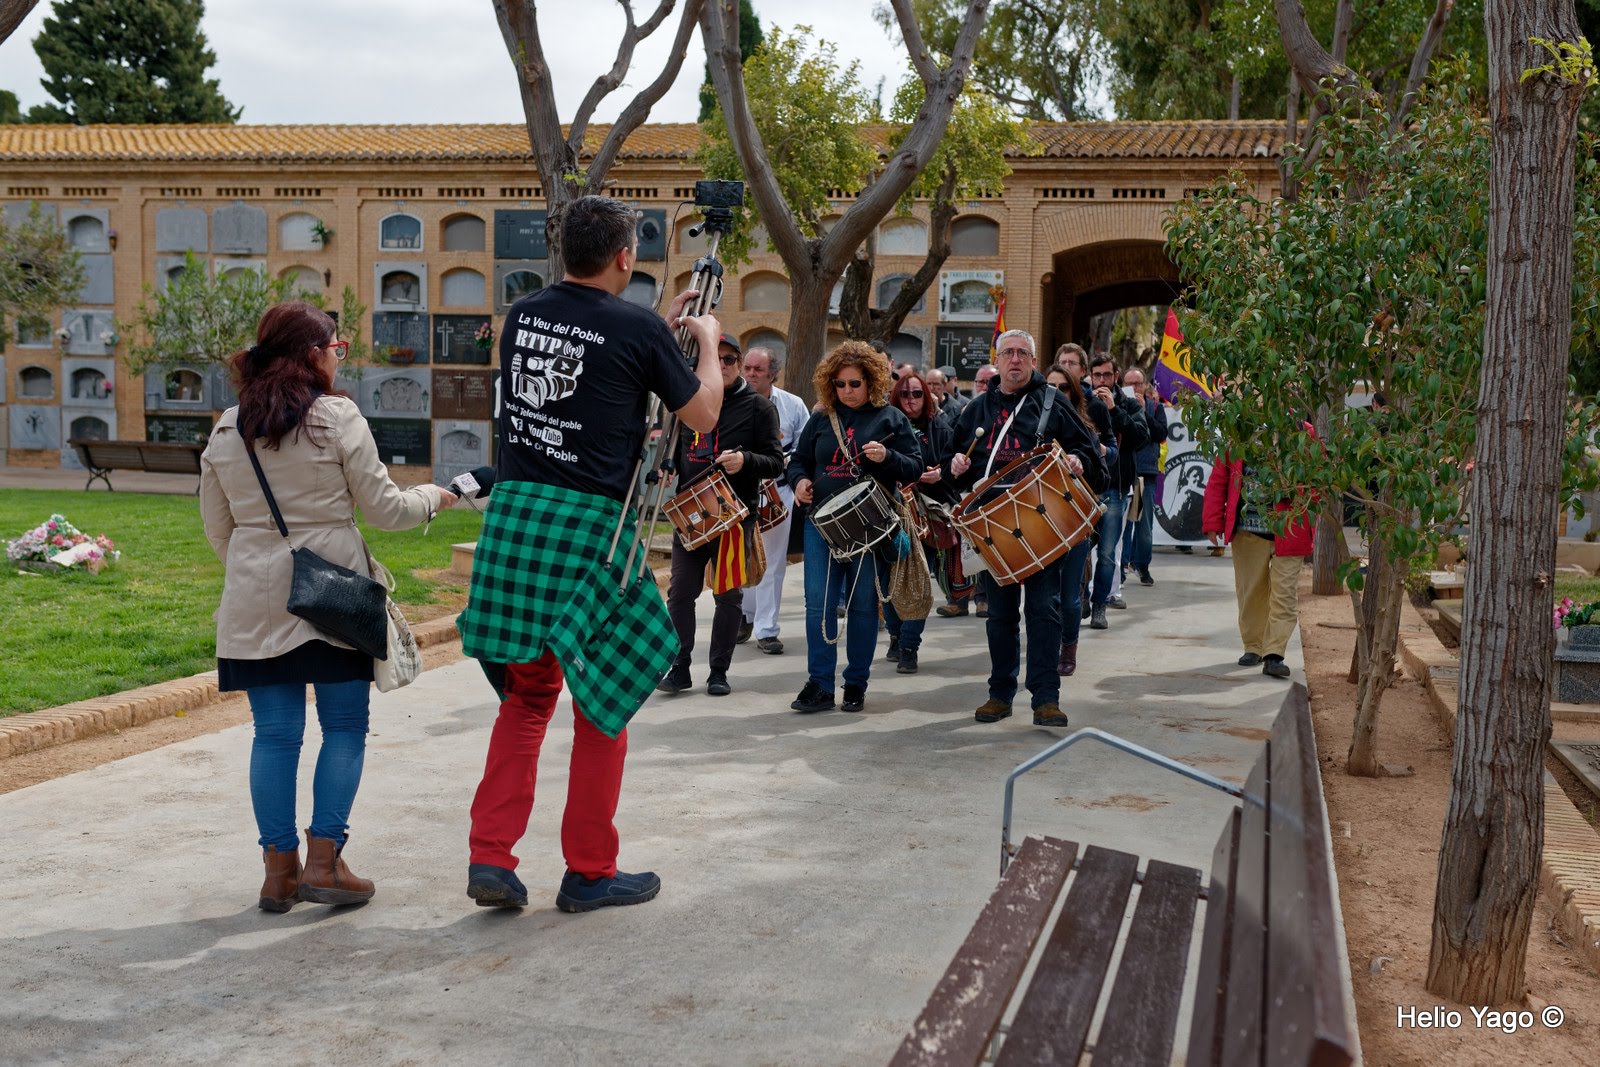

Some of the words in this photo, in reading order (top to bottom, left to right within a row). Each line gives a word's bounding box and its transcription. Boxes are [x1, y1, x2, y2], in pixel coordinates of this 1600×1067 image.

[515, 328, 562, 354] RTVP
[518, 313, 531, 325] La
[533, 316, 551, 331] Veu
[552, 322, 570, 335] del
[570, 326, 605, 345] Poble
[520, 407, 548, 423] Televisió
[548, 416, 559, 426] del
[559, 420, 583, 431] poble
[528, 423, 562, 446] YouTube
[508, 432, 519, 443] La
[546, 446, 578, 463] Poble
[1172, 458, 1181, 466] LA
